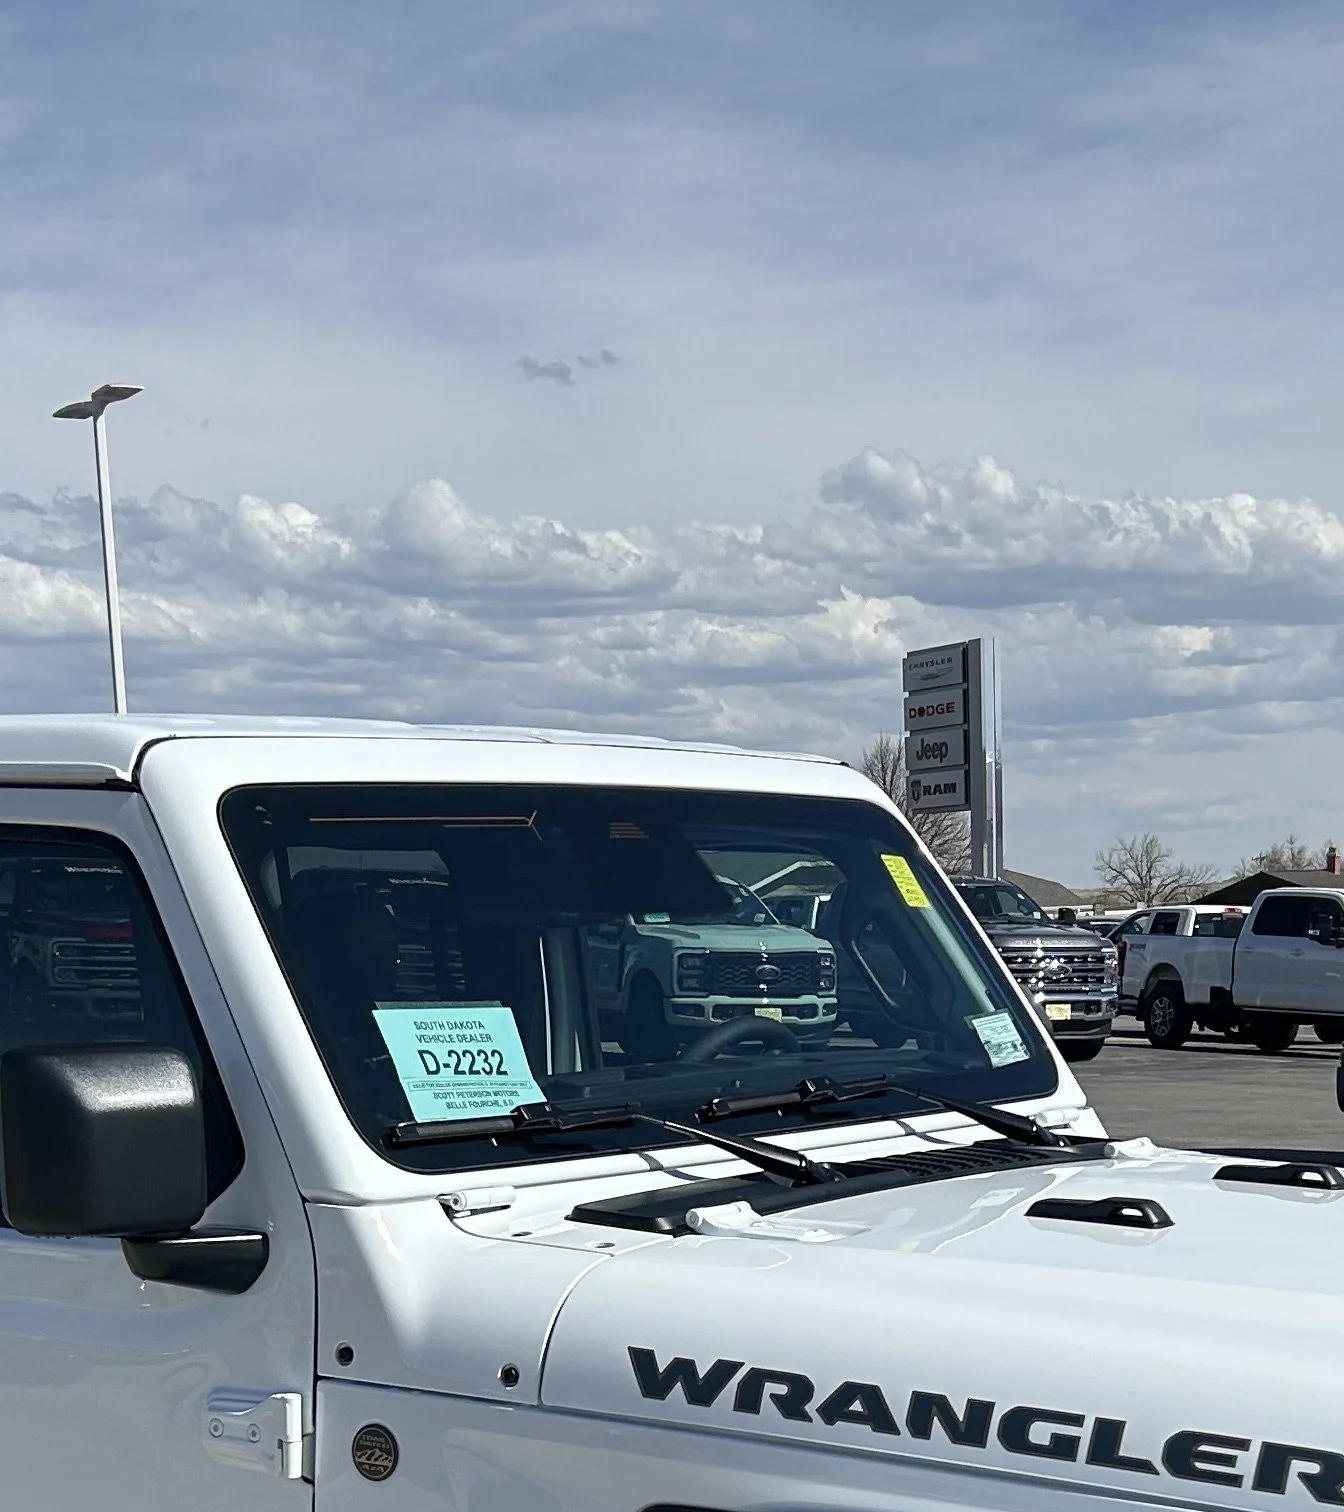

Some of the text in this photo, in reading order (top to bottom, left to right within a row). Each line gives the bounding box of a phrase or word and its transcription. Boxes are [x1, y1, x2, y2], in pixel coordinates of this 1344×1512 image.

[908, 656, 953, 670] CHRYSLER
[908, 702, 956, 719] DODGE
[916, 738, 949, 763] Jeep
[922, 781, 957, 796] RAM
[413, 1020, 486, 1031] SOUTH DAKOTA
[415, 1033, 494, 1043] VEHICLE DEALER
[417, 1049, 509, 1076] D-2232
